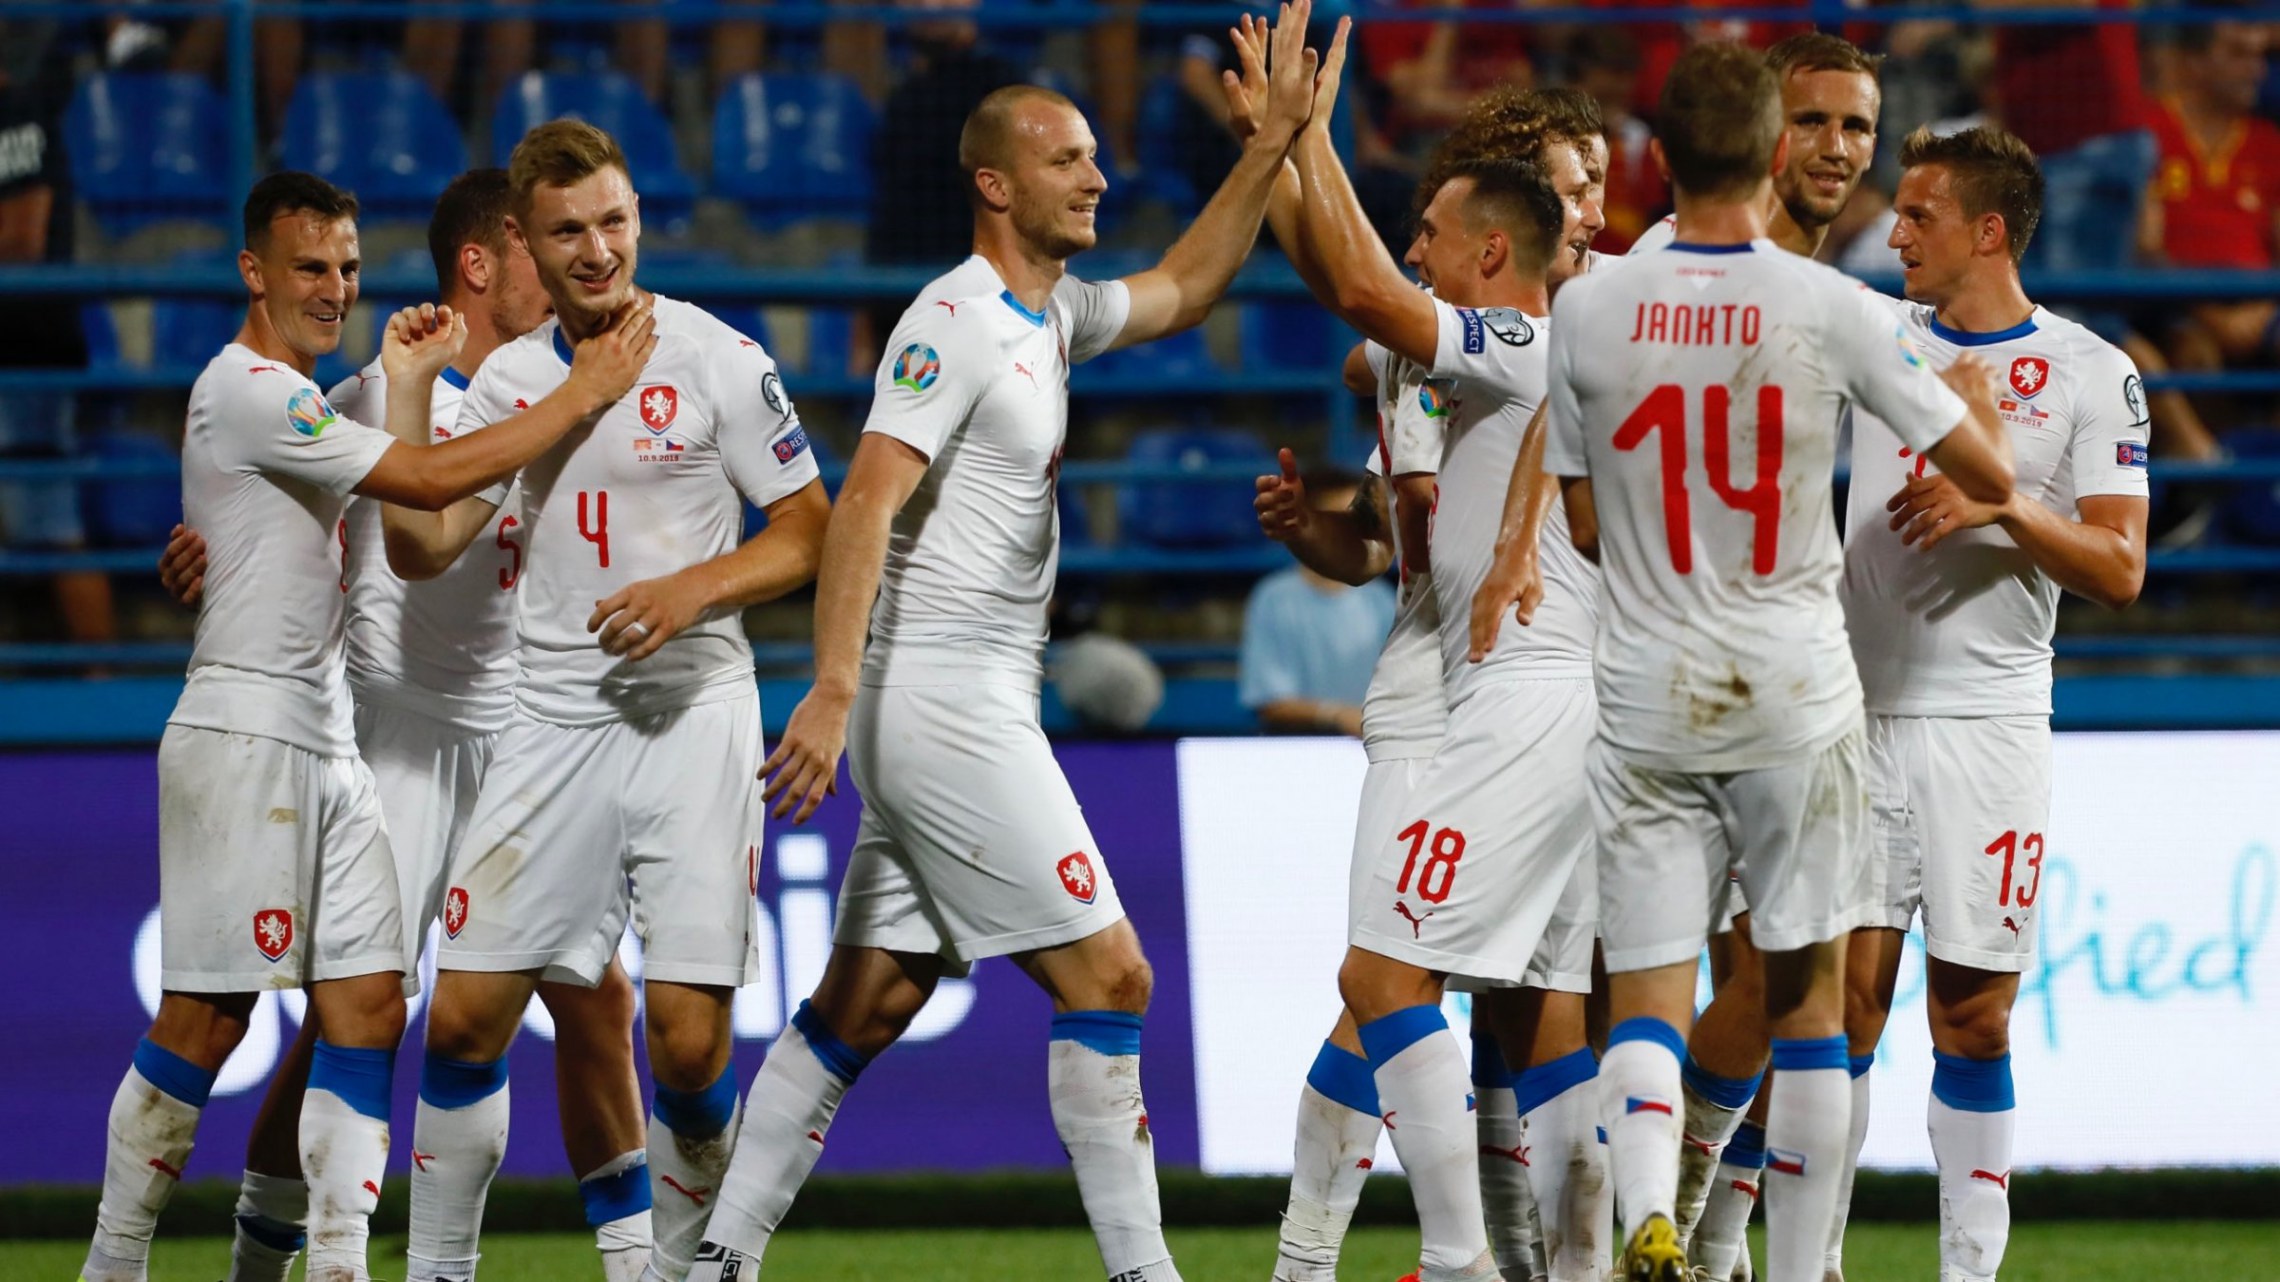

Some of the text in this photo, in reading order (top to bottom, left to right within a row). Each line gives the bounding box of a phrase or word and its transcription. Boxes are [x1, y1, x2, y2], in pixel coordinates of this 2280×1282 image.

[1465, 310, 1480, 352] RESPECT
[1630, 303, 1761, 346] JANKTO
[1612, 384, 1783, 575] 14
[497, 515, 522, 591] 5
[577, 491, 610, 568] 4
[1396, 819, 1466, 905] 18
[1985, 830, 2045, 908] 13
